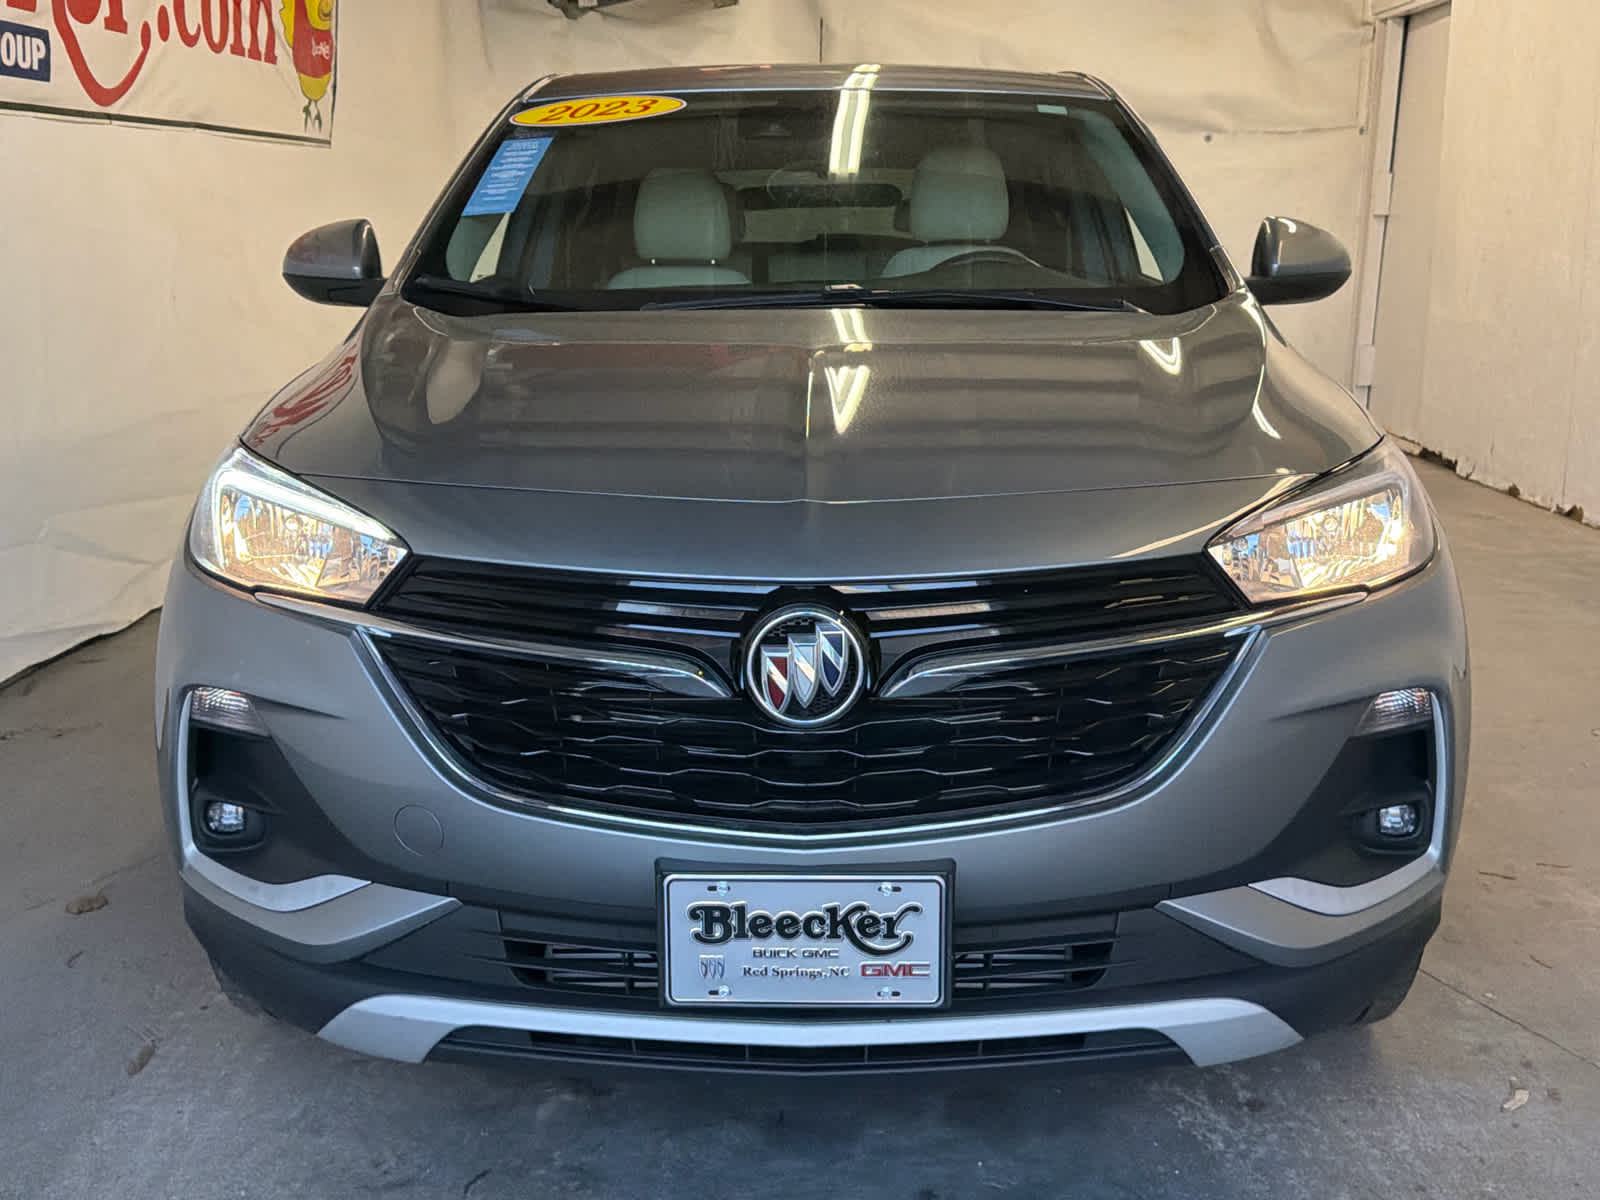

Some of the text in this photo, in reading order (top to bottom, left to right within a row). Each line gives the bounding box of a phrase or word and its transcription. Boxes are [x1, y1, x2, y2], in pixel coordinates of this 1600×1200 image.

[538, 98, 660, 122] 2023
[752, 947, 840, 958] BUICK GMC
[743, 966, 768, 977] Red
[772, 966, 826, 979] Springs,
[860, 962, 931, 978] GMC
